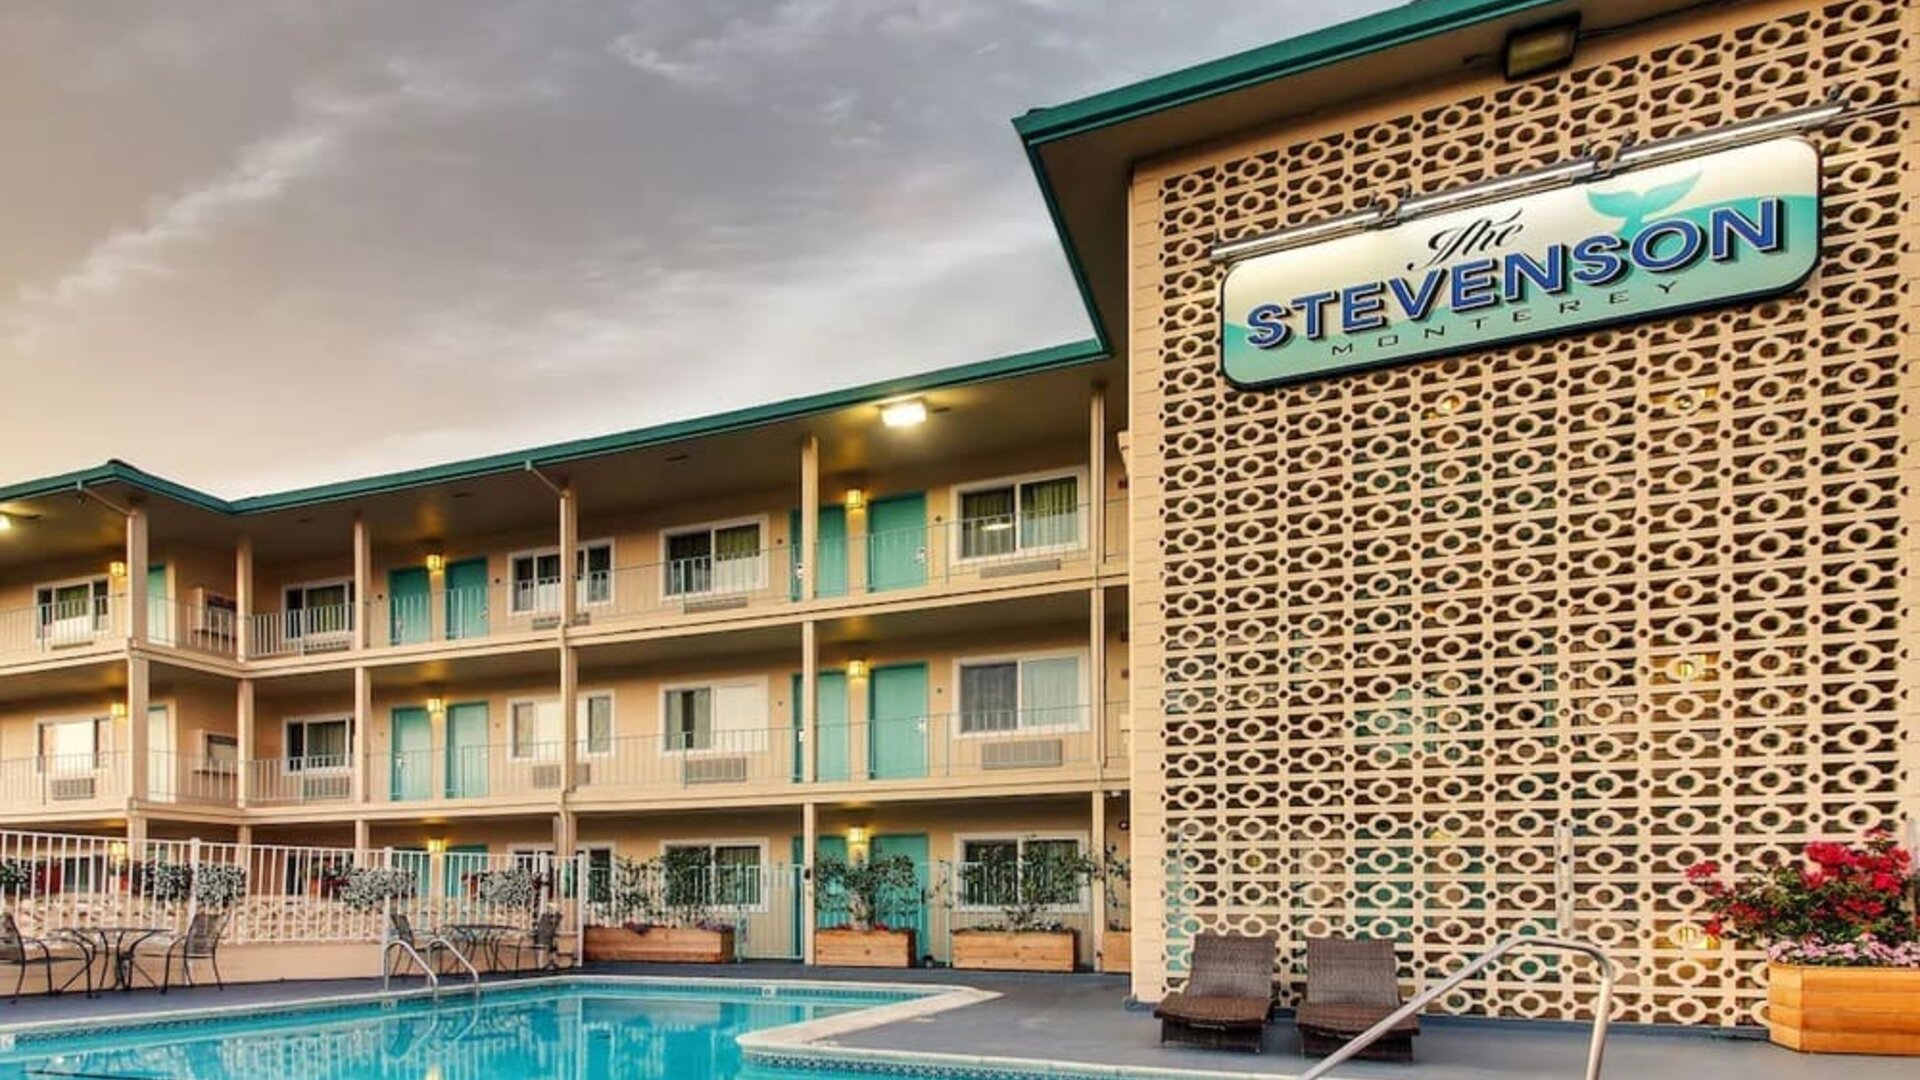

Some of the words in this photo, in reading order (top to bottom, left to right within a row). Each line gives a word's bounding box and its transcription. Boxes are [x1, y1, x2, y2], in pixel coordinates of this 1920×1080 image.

[1246, 197, 1786, 350] STEVENSON
[1407, 208, 1524, 271] The
[1331, 280, 1678, 357] MONTEREY
